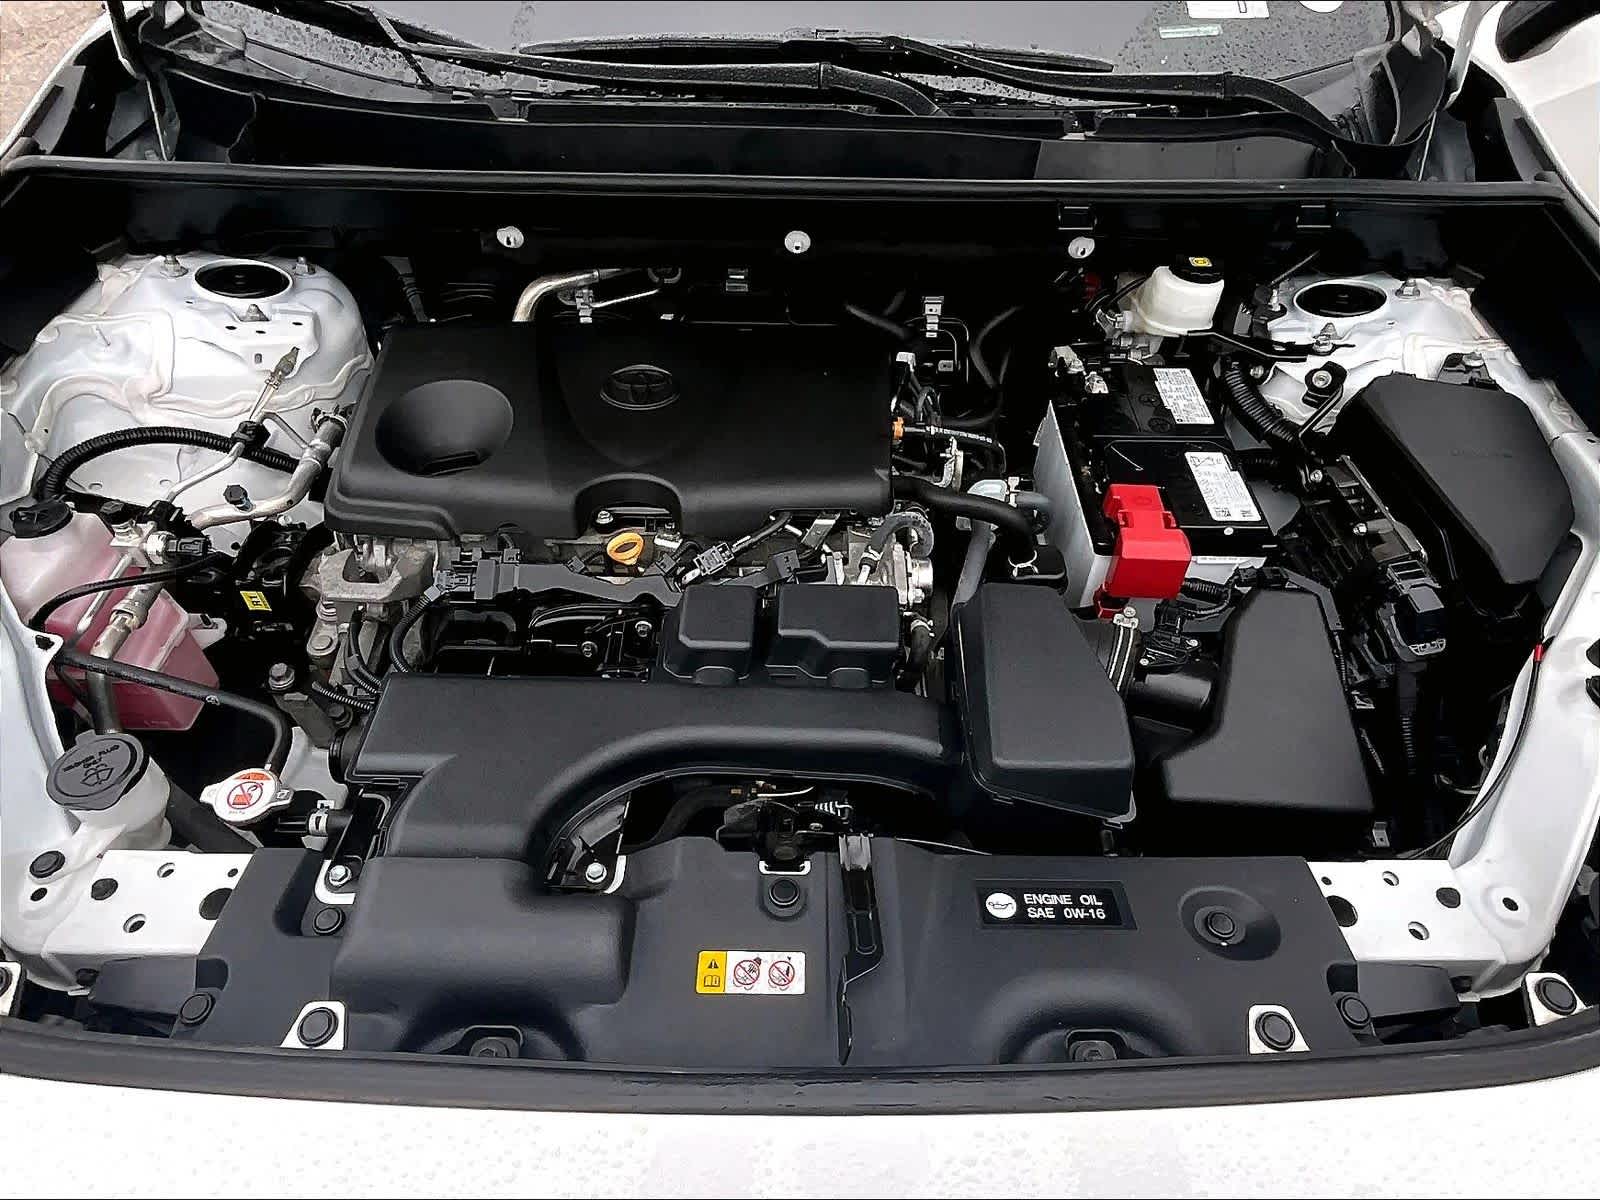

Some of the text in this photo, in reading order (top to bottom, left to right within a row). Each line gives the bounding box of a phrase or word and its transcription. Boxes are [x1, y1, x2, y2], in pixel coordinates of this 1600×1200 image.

[1023, 893, 1103, 906] ENGINE OIL
[1027, 907, 1106, 920] SAE 0W-16
